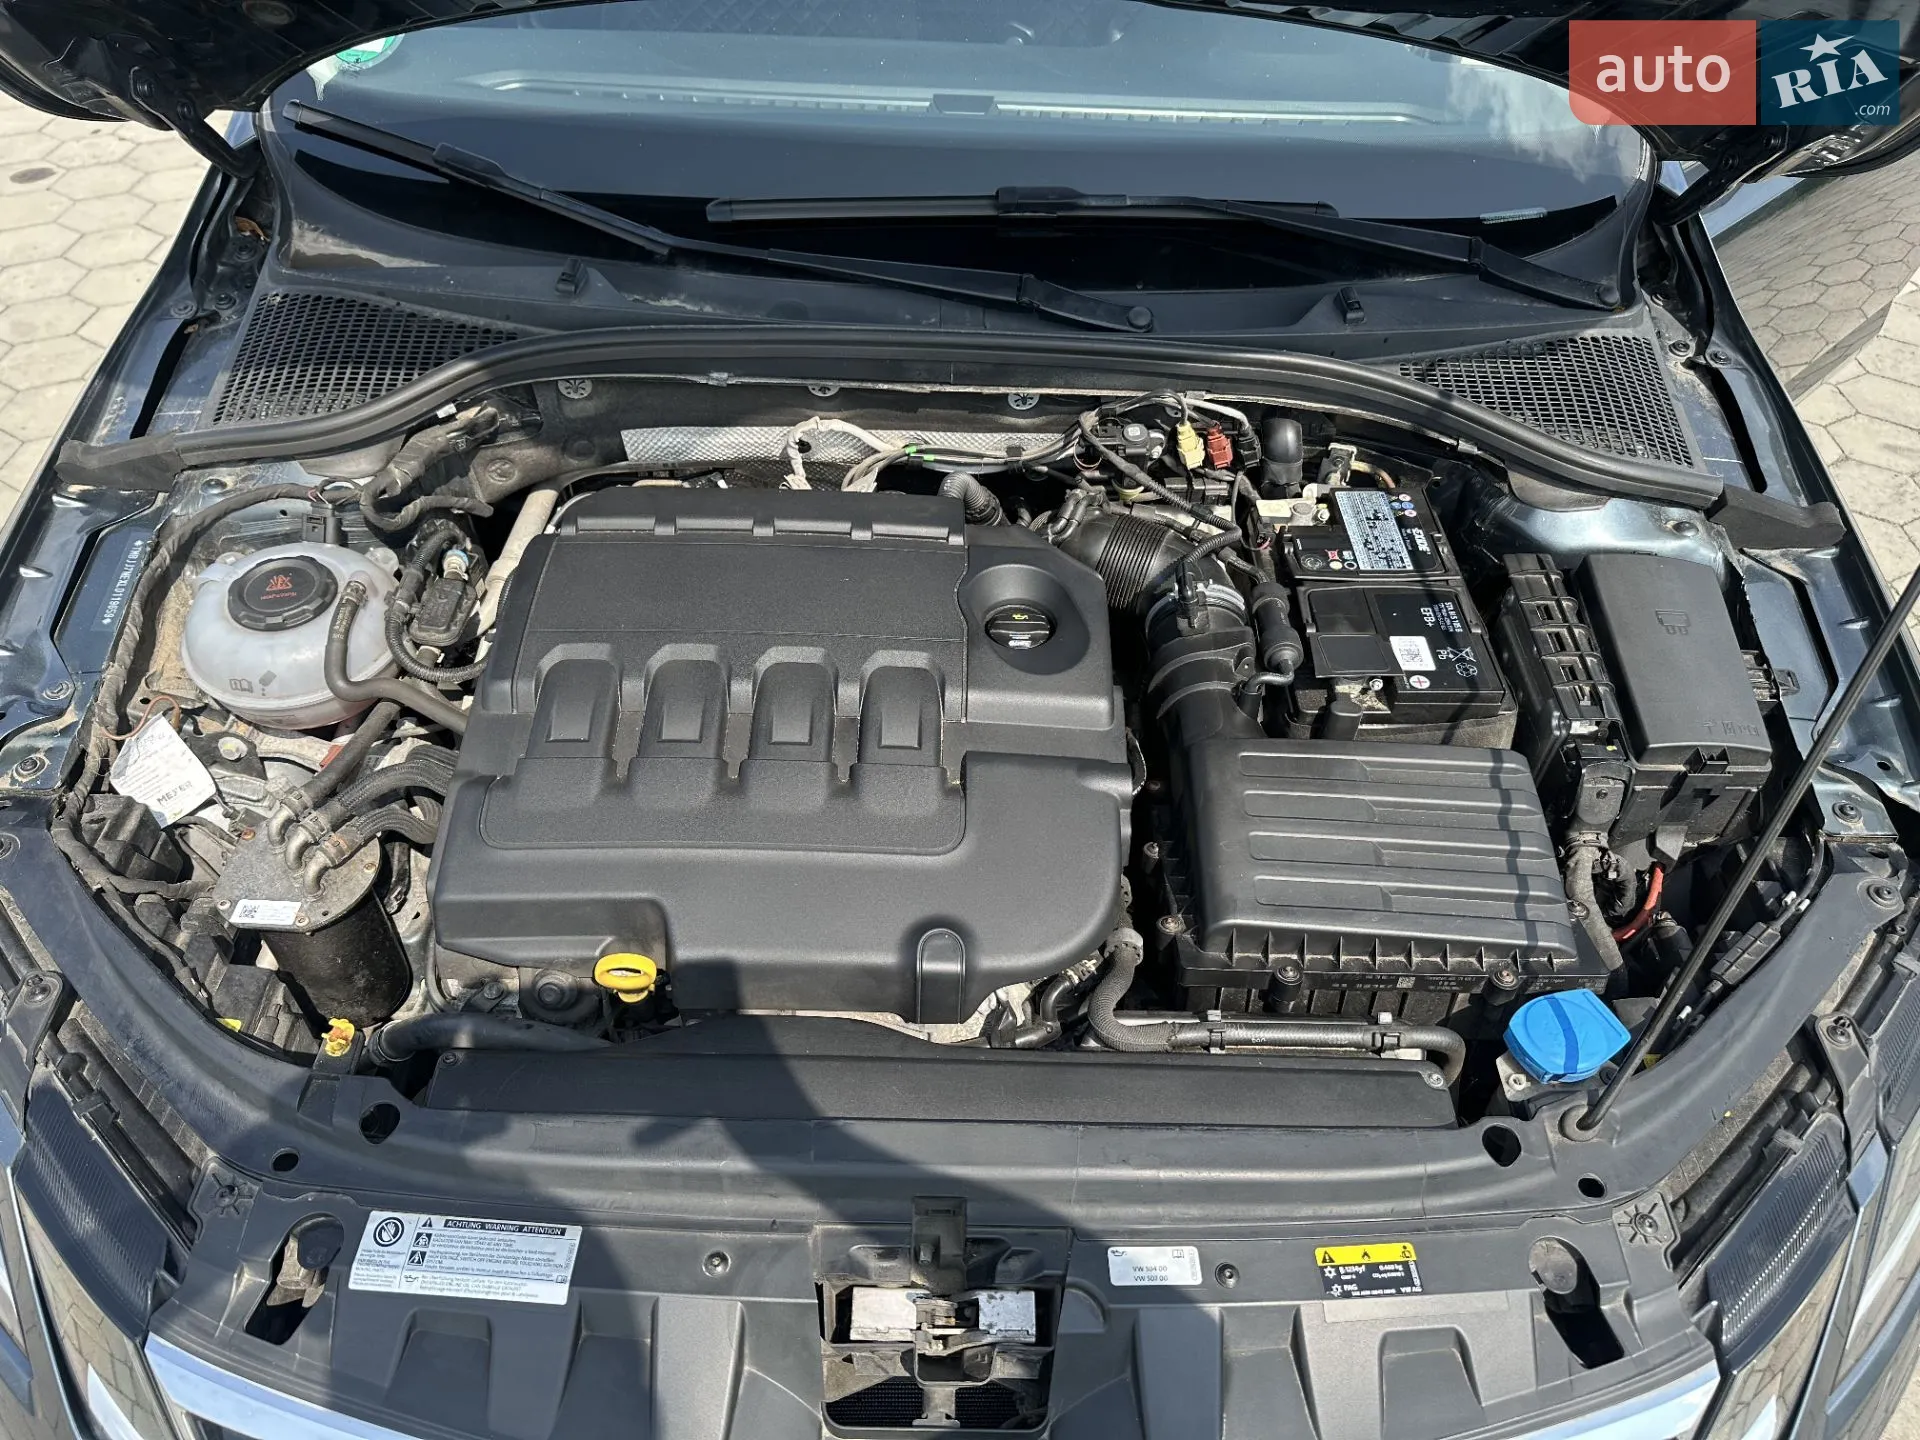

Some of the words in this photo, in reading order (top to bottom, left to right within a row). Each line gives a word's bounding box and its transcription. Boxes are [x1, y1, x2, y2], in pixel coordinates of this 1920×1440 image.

[1412, 528, 1430, 551] EXIDE
[1420, 607, 1436, 627] EFB+
[1436, 649, 1448, 660] Pb
[446, 1220, 482, 1229] ACHTUNG
[485, 1223, 520, 1232] WARNING
[522, 1226, 562, 1235] ATTENTION
